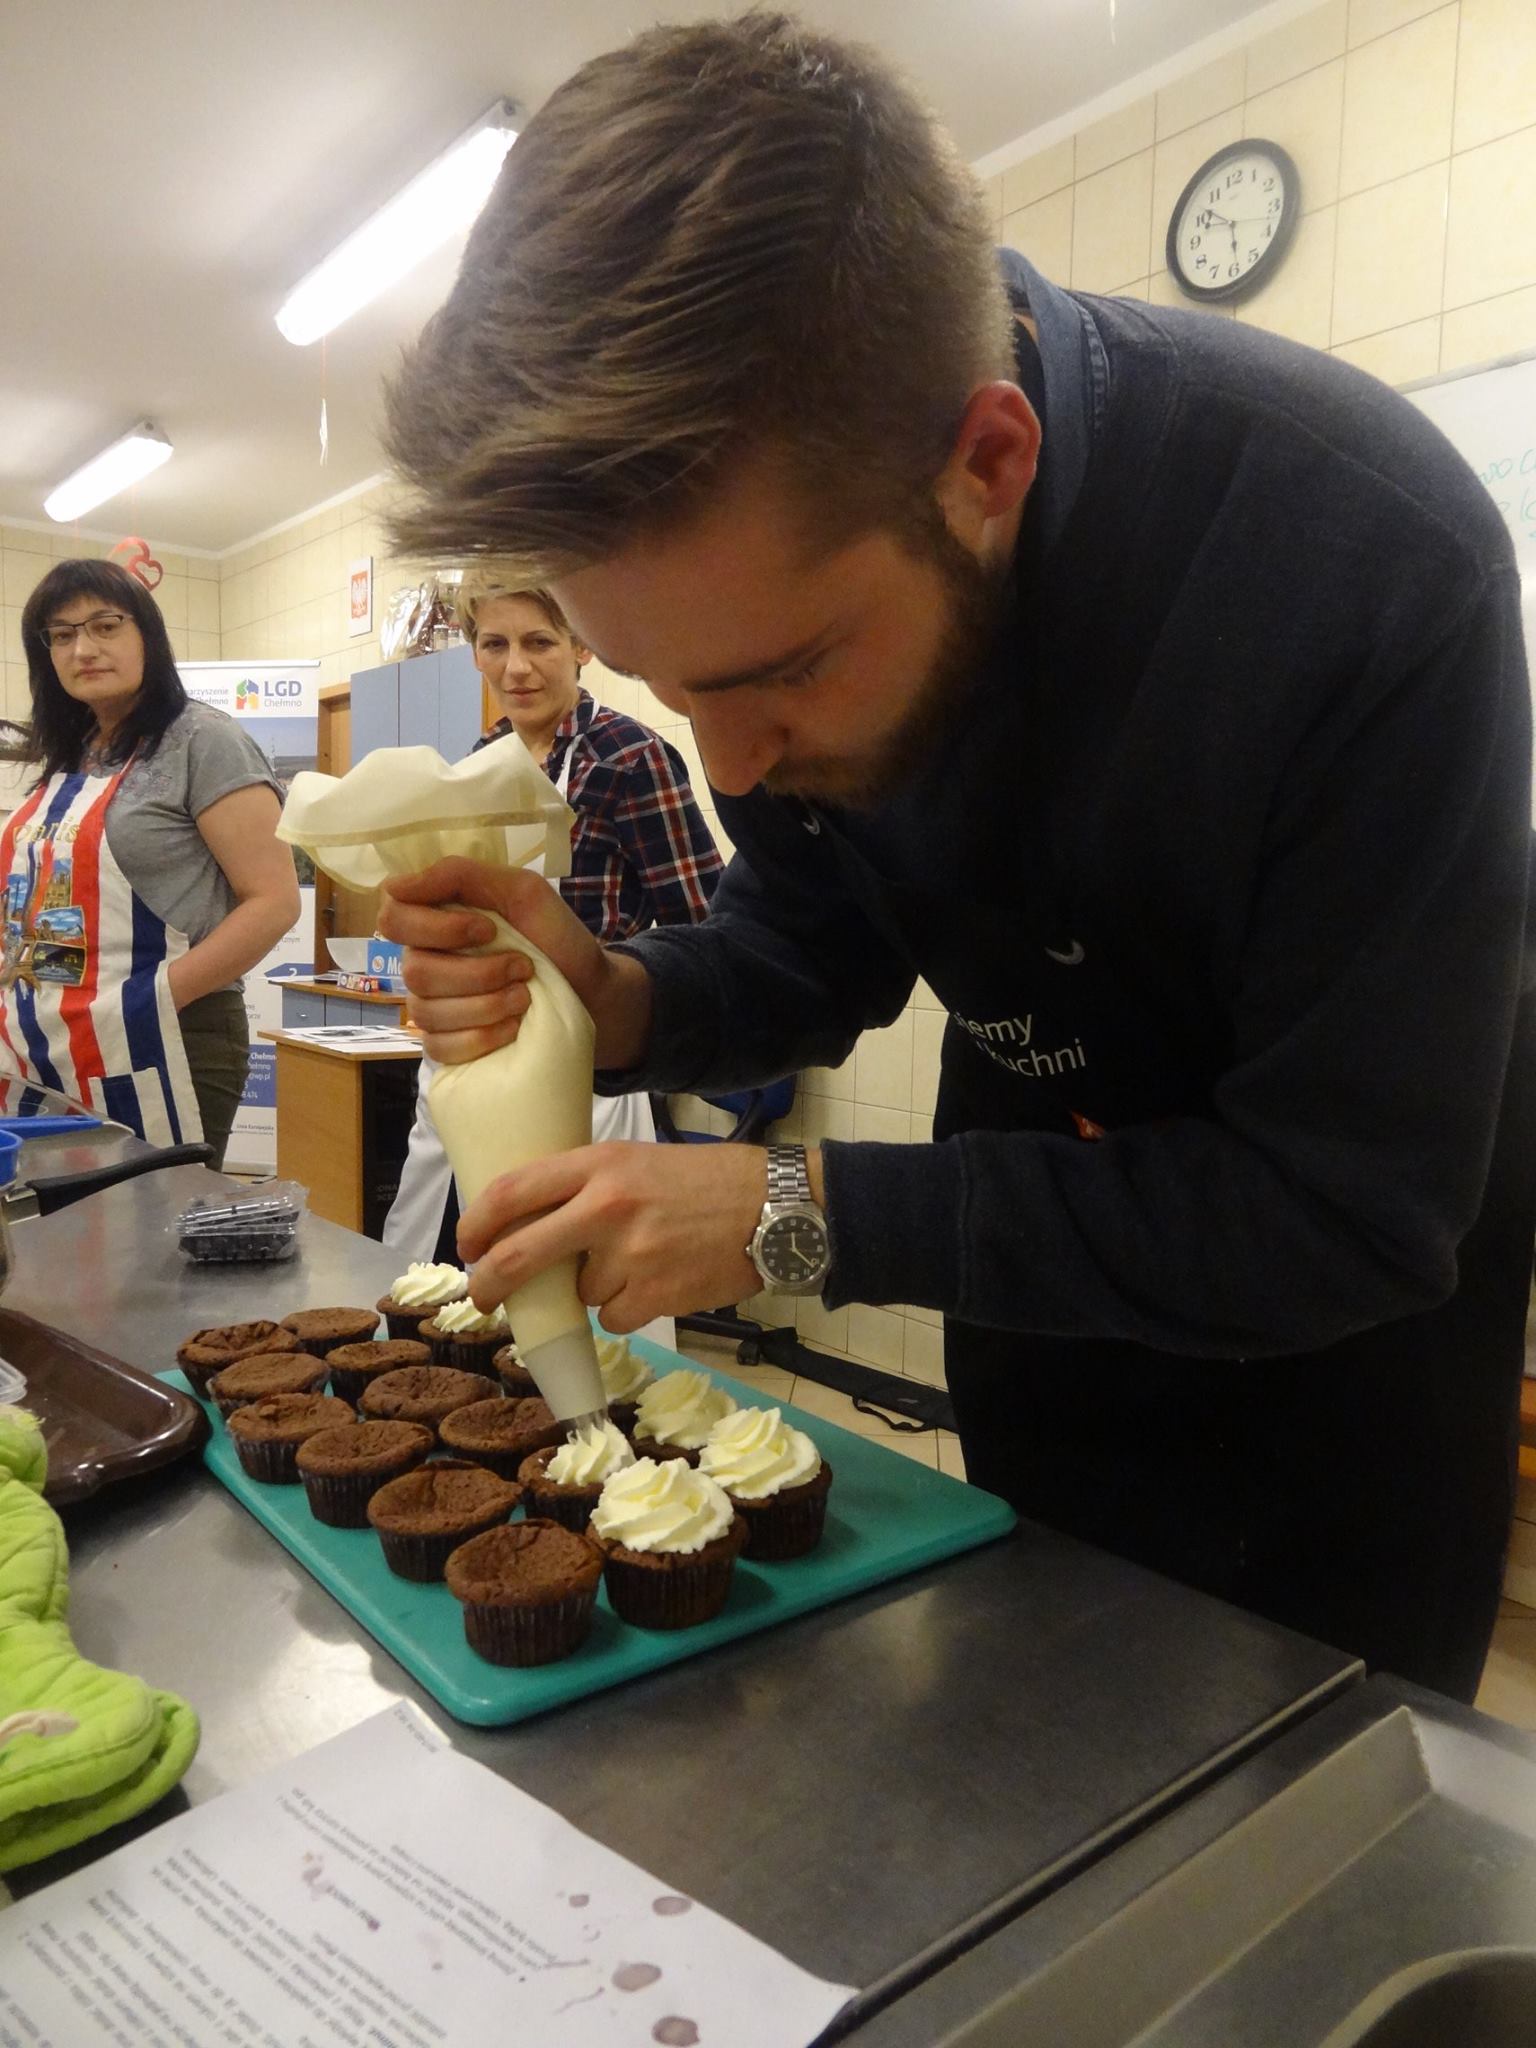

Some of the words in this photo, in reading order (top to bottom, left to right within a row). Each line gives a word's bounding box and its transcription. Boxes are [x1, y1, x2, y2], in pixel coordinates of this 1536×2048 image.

[1225, 169, 1244, 189] 12
[1262, 177, 1275, 193] 2
[1208, 187, 1222, 204] 11
[1267, 198, 1281, 214] 3
[1260, 224, 1272, 239] 4
[1190, 235, 1201, 251] 9
[1195, 254, 1207, 269] 8
[1247, 247, 1259, 263] 5
[1209, 264, 1220, 280] 7
[1228, 262, 1240, 278] 6
[264, 680, 302, 697] LGD
[250, 1052, 276, 1060] Chełmn
[248, 1072, 271, 1081] @wp.pl
